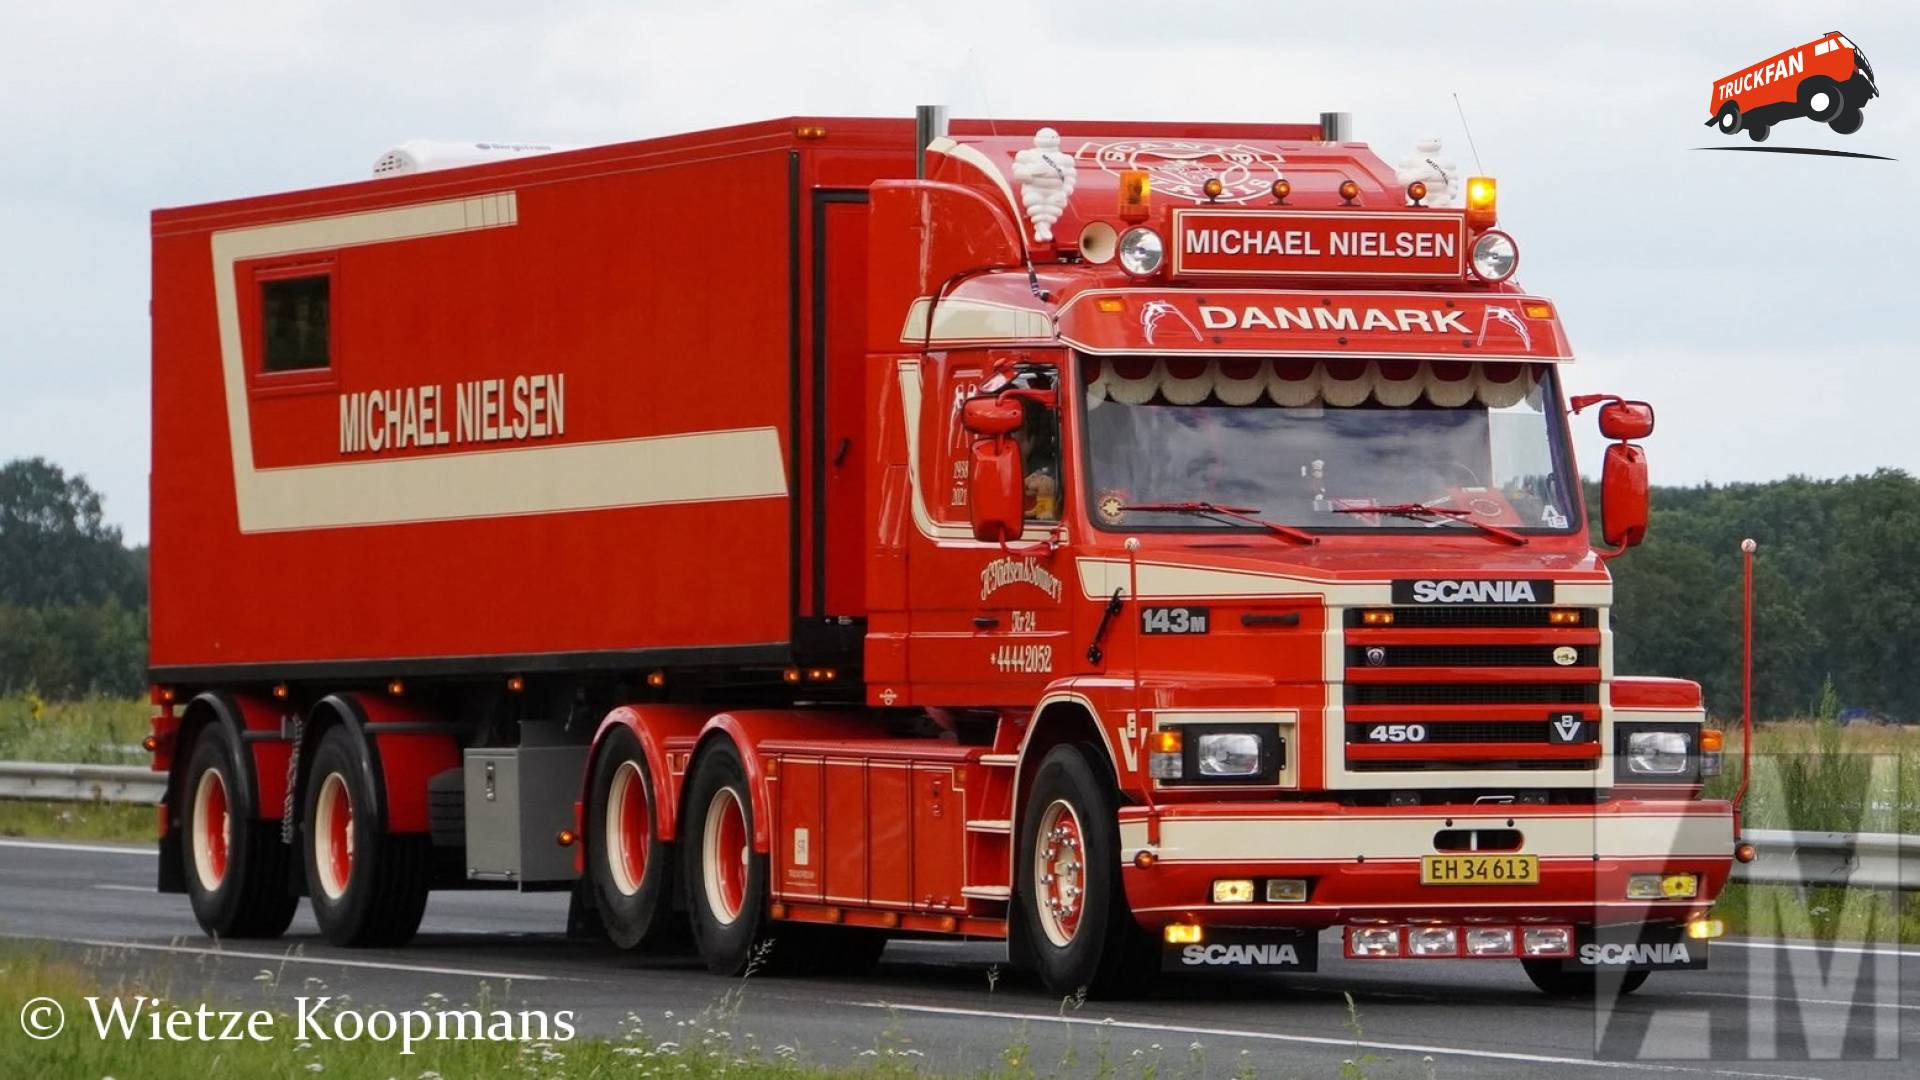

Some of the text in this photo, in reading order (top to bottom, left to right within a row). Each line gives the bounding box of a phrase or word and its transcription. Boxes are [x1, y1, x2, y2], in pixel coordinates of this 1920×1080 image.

[1185, 229, 1456, 259] MICHAEL NIELSEN
[1199, 305, 1473, 336] DANMARK
[339, 373, 565, 453] MICHAEL NIELSEN
[1412, 580, 1537, 604] SCANIA
[1369, 724, 1426, 742] 450
[1181, 944, 1299, 966] SCANIA
[1579, 943, 1691, 965] SCANIA
